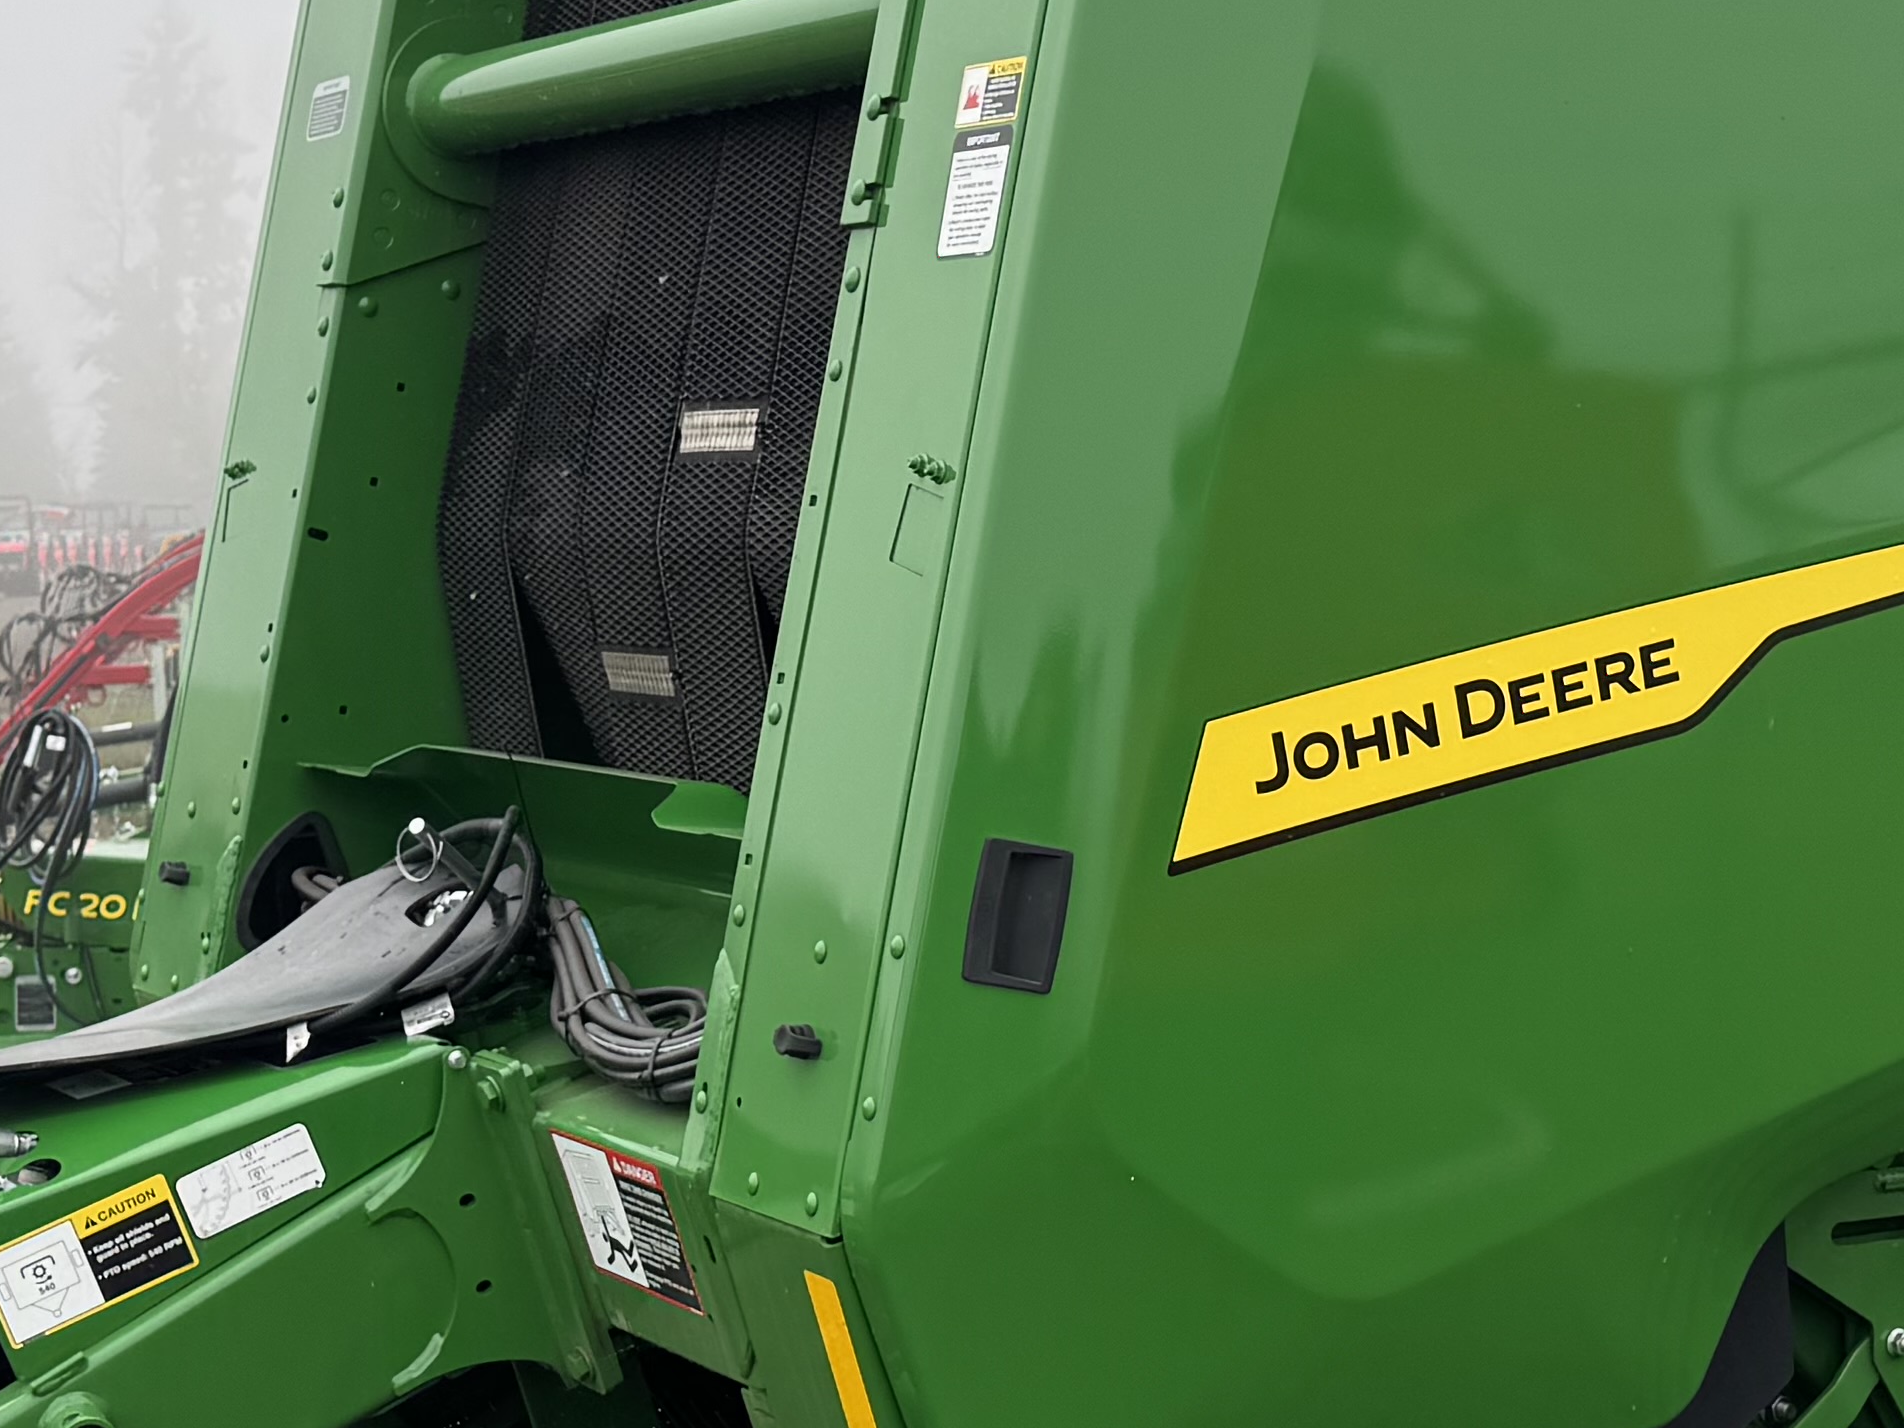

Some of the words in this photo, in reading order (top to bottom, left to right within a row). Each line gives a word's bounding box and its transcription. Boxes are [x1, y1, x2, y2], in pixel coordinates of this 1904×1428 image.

[1256, 702, 1440, 794] JOHN
[1454, 638, 1680, 738] DEERE
[97, 1188, 156, 1222] CAUTION
